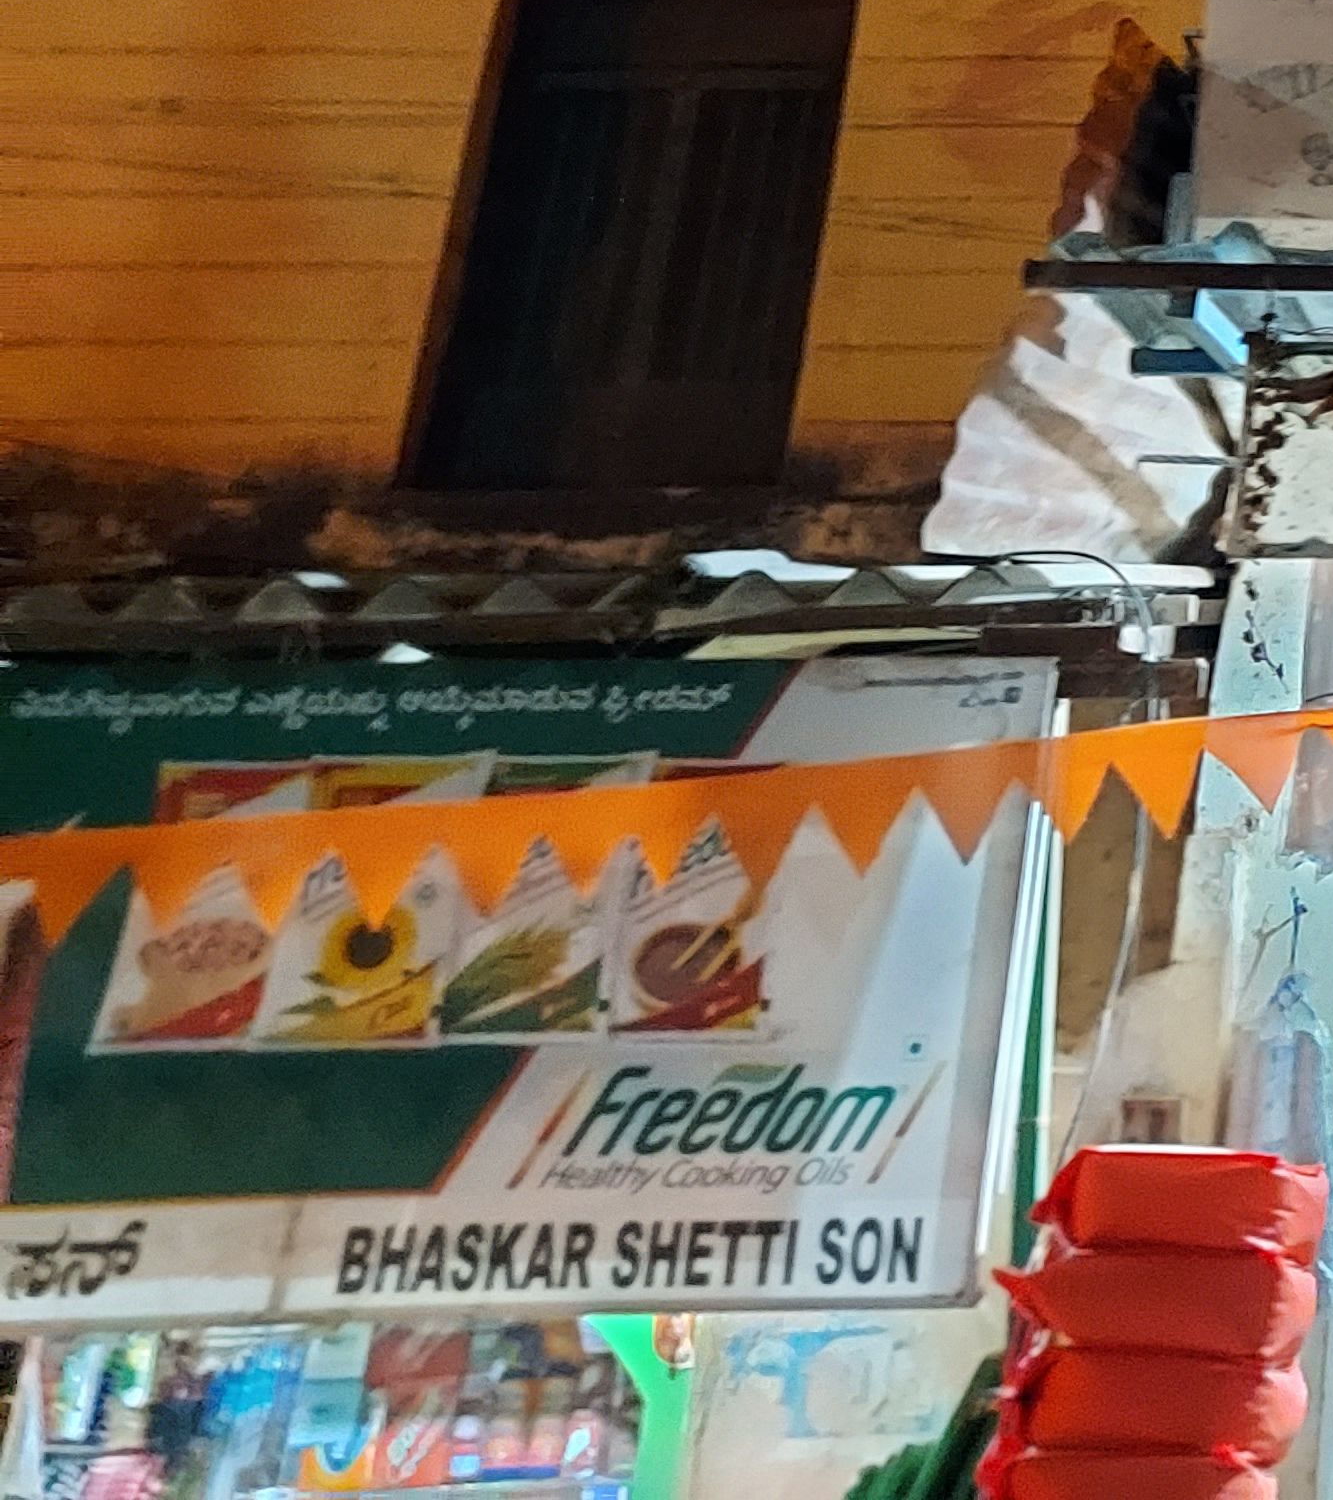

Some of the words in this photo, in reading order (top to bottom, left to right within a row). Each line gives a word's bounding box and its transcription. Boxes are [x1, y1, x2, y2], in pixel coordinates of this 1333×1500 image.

[561, 1062, 896, 1157] Freedom
[540, 1157, 661, 1193] Healthy
[661, 1157, 790, 1193] Cooking
[793, 1156, 856, 1188] Oils
[335, 1221, 597, 1295] BHASKAR
[609, 1218, 800, 1289] SHETTI
[815, 1216, 924, 1287] SON
